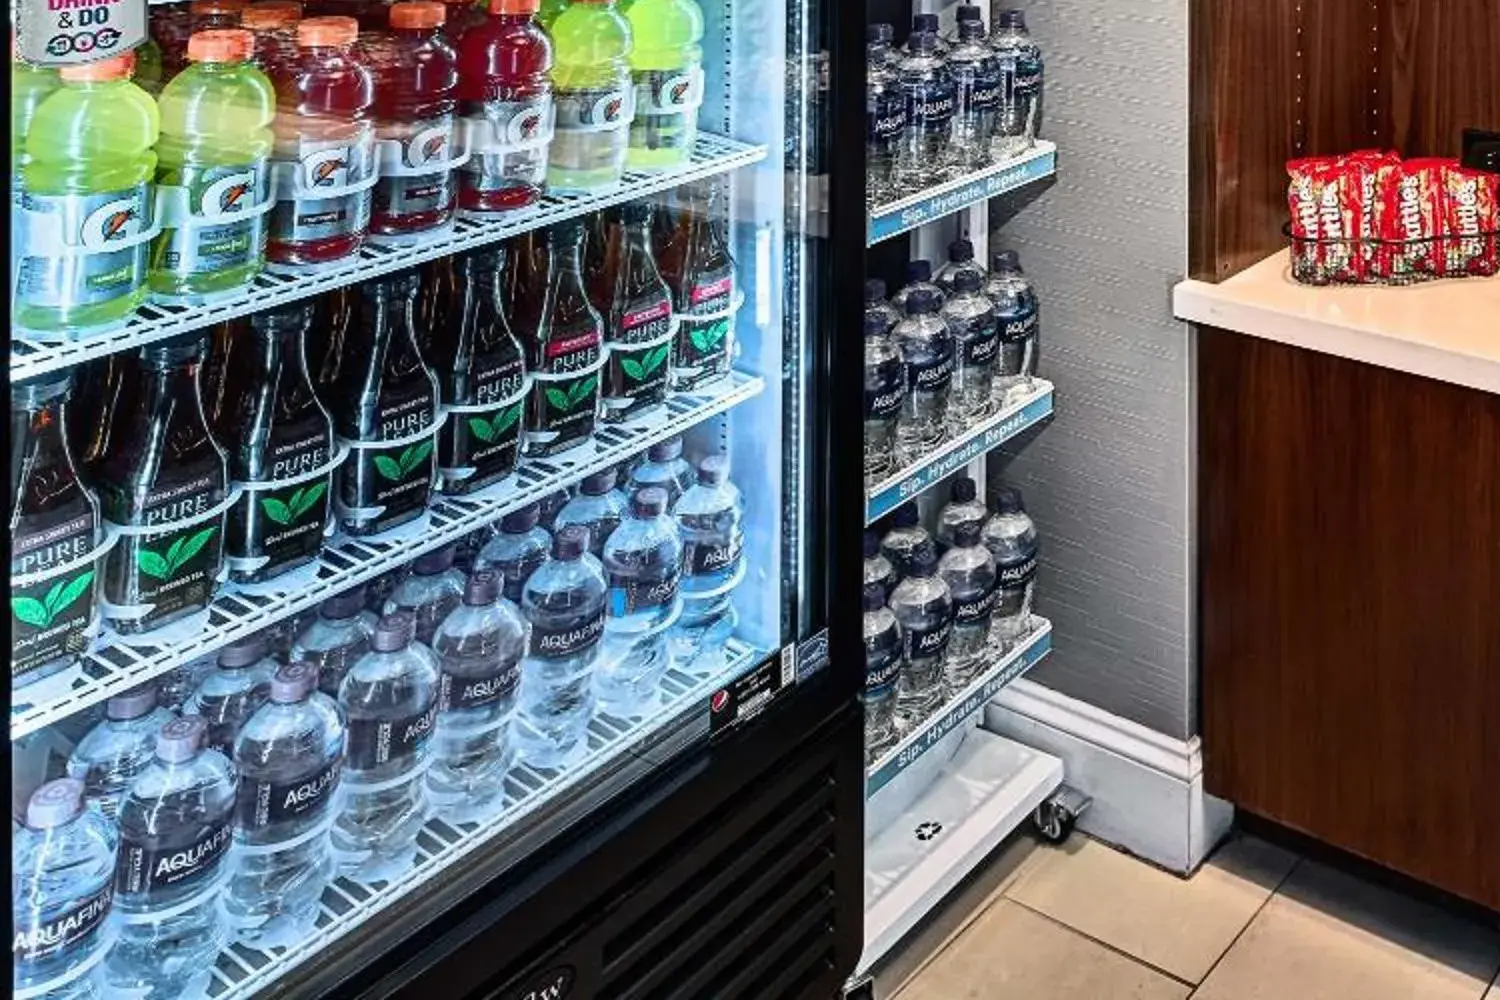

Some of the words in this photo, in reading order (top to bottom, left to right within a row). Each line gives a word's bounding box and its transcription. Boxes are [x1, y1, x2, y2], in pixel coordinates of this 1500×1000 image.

[58, 12, 73, 28] &
[79, 6, 109, 26] DO
[901, 208, 926, 225] Sip.
[931, 186, 985, 213] Hydrate.
[477, 373, 523, 396] PURE
[382, 410, 431, 436] PURE
[273, 450, 323, 477] PURE
[899, 479, 925, 497] Sip.
[927, 444, 980, 479] Hydrate.
[147, 493, 208, 523] PURE
[21, 535, 88, 572] PURE
[897, 745, 923, 767] Sip.
[926, 699, 982, 744] Hydrate.
